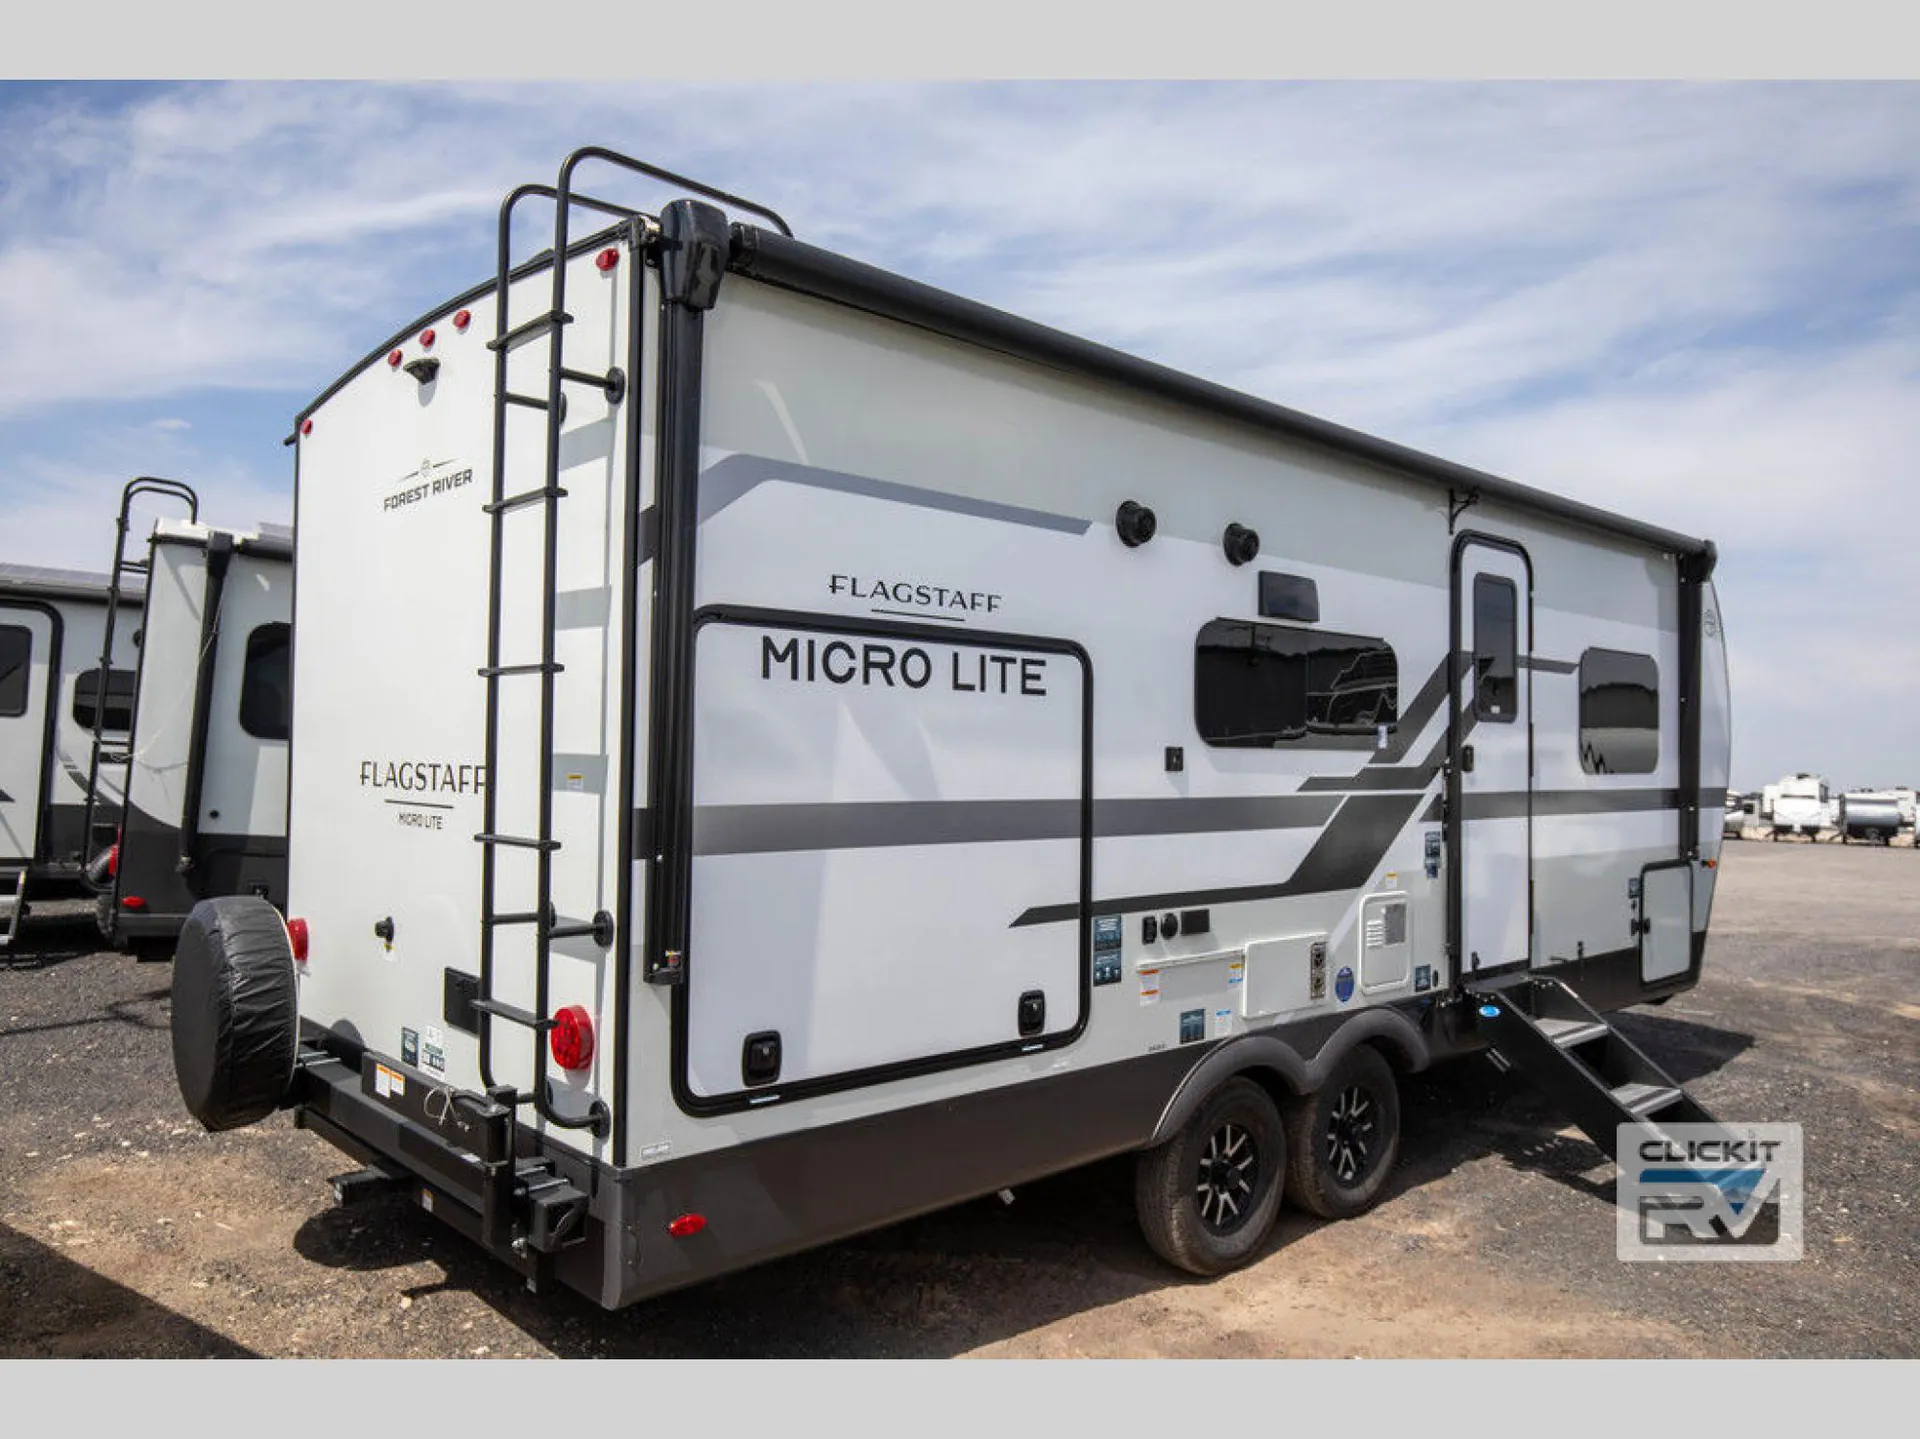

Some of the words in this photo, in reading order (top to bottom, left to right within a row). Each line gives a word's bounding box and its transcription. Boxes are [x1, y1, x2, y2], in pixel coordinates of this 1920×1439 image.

[383, 484, 430, 512] FOREST
[432, 468, 473, 495] RIVER
[828, 574, 1003, 613] FLAGSTAFF
[761, 635, 932, 689] MICRO
[951, 651, 1047, 696] LITE
[360, 761, 487, 794] FLAGSTAFF
[398, 812, 423, 827] MICRO
[424, 815, 443, 830] LITE
